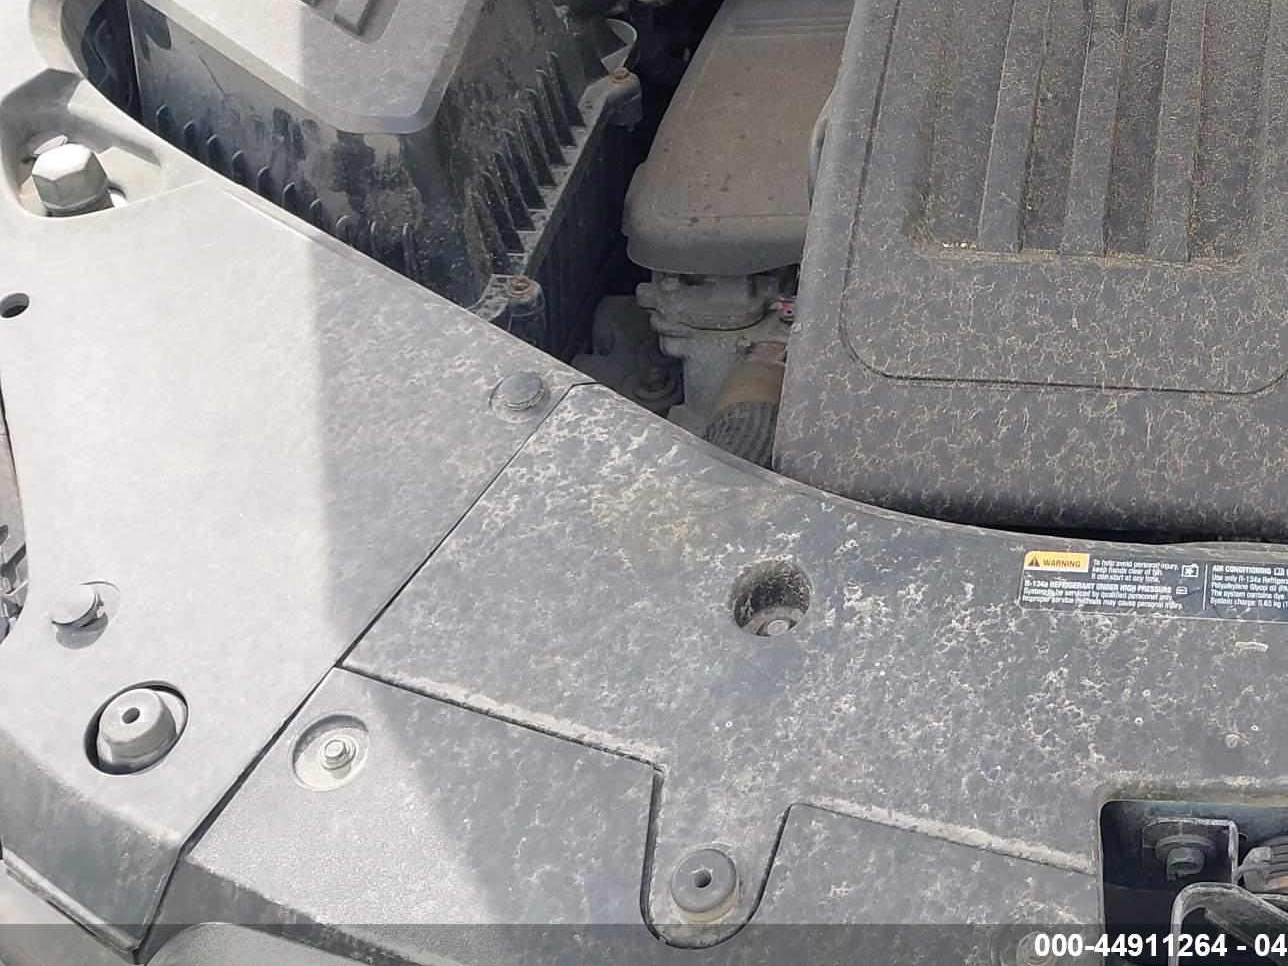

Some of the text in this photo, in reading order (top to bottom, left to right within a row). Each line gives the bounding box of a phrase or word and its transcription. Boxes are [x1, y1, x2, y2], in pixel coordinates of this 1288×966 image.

[1043, 560, 1080, 568] WARNING
[1225, 566, 1272, 574] CONDITIONING
[1050, 581, 1095, 590] REFRIGERANT
[1138, 585, 1172, 594] PRESSURE
[1250, 584, 1268, 592] Glycol
[1022, 595, 1050, 603] Improper
[1137, 600, 1164, 608] personal
[1092, 590, 1100, 599] by
[1101, 592, 1126, 600] qualified
[1128, 594, 1158, 602] personnel
[1210, 596, 1232, 605] System
[1274, 600, 1282, 608] kg
